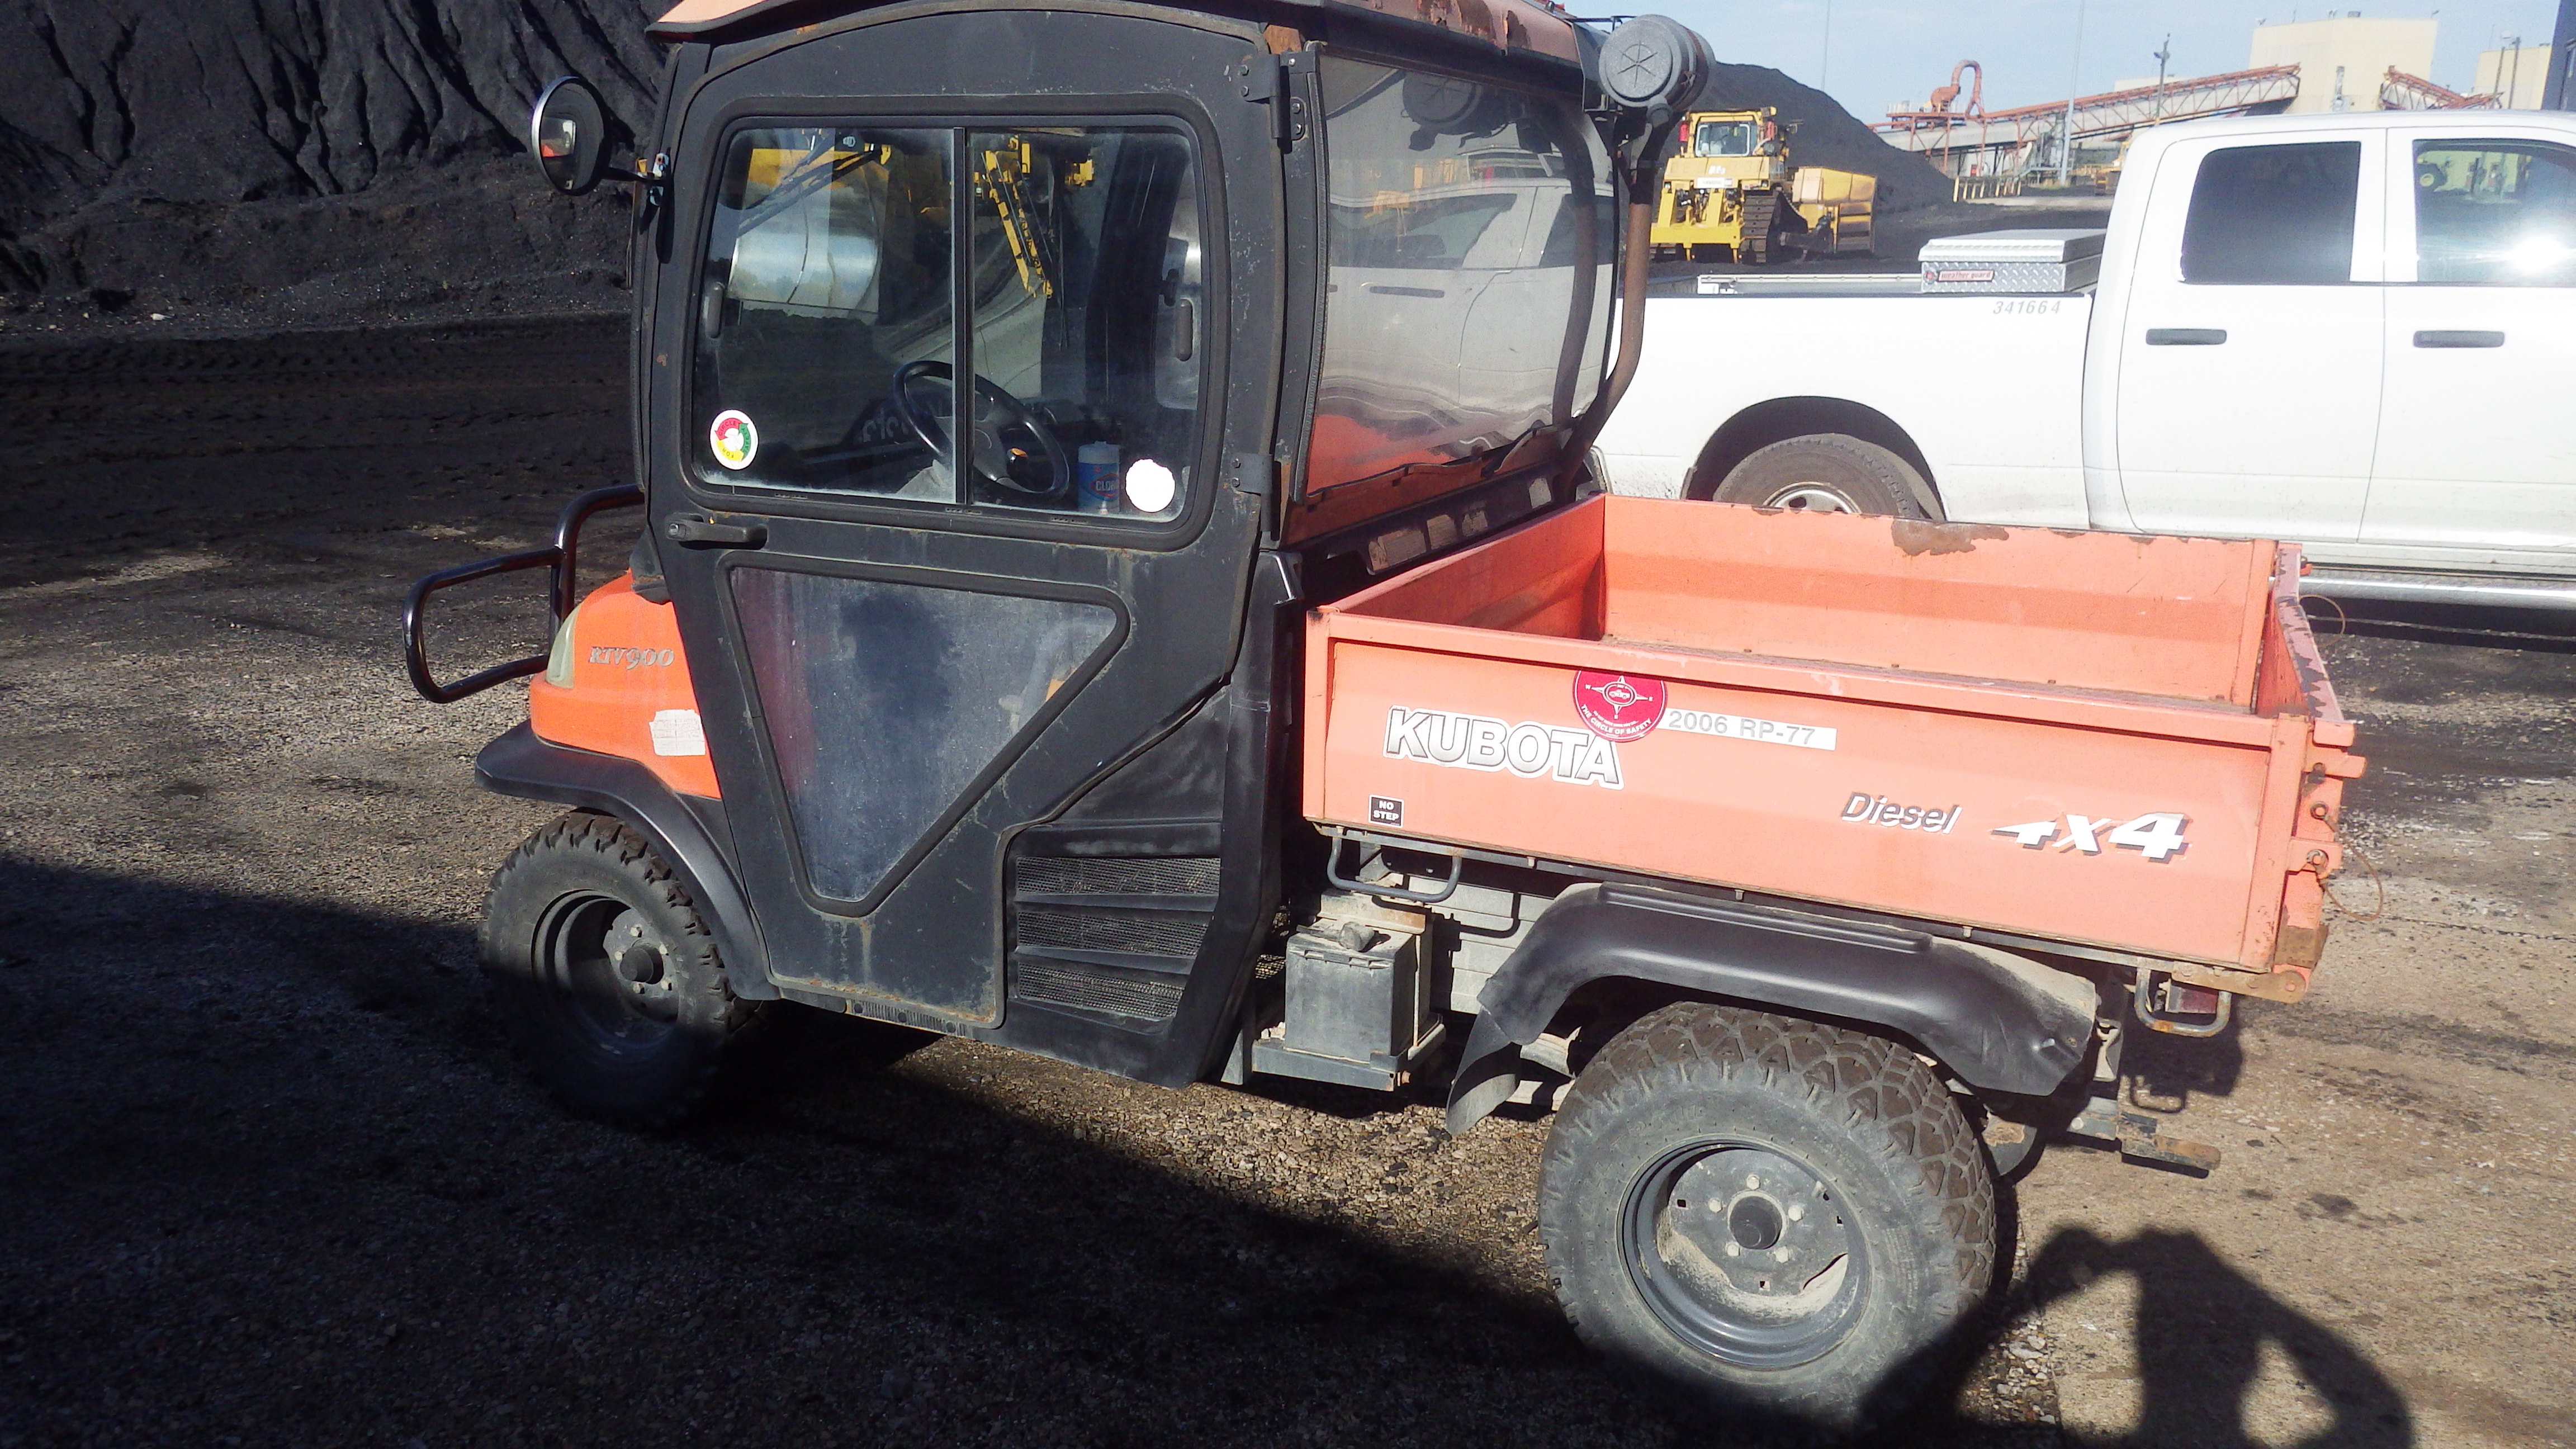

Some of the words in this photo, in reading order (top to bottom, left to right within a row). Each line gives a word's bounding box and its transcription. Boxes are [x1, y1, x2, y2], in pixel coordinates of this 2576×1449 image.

[1993, 300, 2061, 314] 341664
[718, 420, 736, 436] CIRCLE
[1096, 480, 1117, 491] CLOR
[589, 646, 675, 670] RTV900
[1581, 703, 1592, 719] THE
[1590, 717, 1613, 734] CIRCLE
[1626, 717, 1652, 735] SAFETY
[1668, 710, 1728, 734] 2006
[1739, 718, 1815, 745] RP-77
[1385, 707, 1621, 785] KUBOTA
[1373, 809, 1399, 821] STEP
[1379, 800, 1394, 811] NO
[1841, 791, 1962, 835] Diesel
